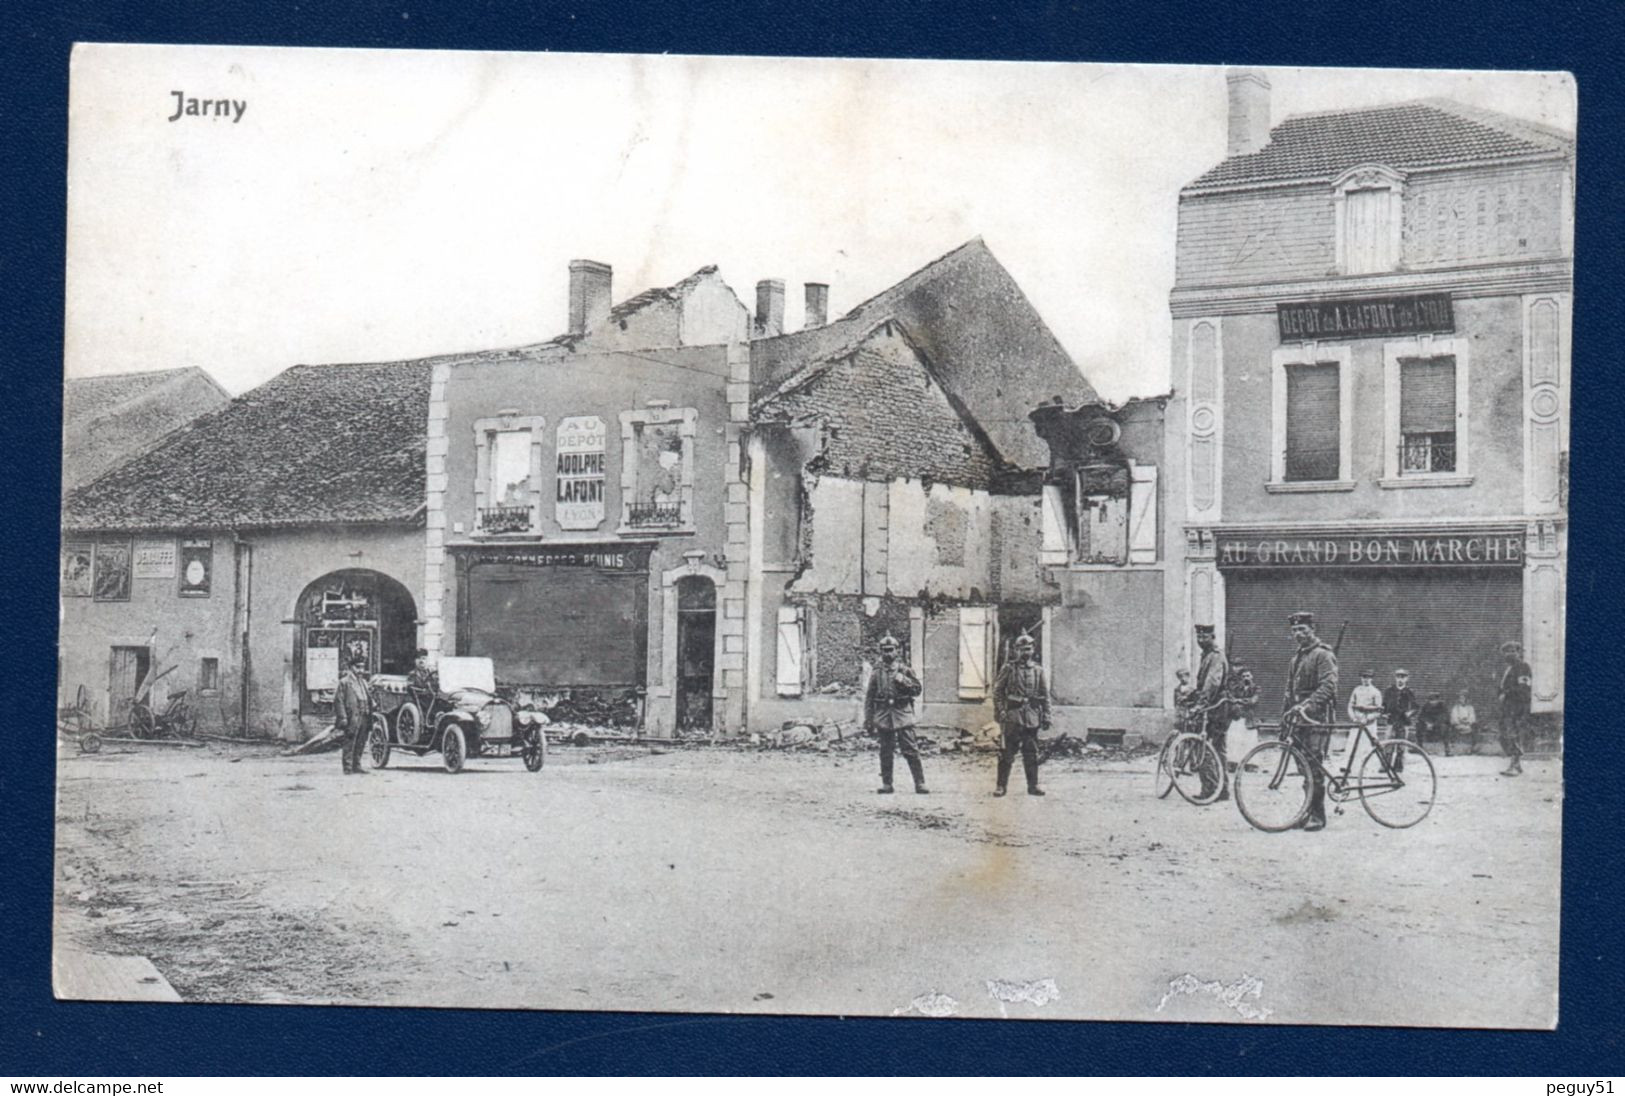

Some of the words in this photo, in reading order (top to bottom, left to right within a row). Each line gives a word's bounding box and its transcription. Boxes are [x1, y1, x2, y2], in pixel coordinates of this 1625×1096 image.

[1346, 303, 1396, 330] LAFONT
[567, 420, 597, 431] AU
[557, 453, 604, 475] ADOLPHE
[557, 478, 604, 502] LAFONT
[1221, 544, 1248, 563] AU
[1256, 541, 1338, 563] GRAND
[1351, 539, 1400, 562] BON
